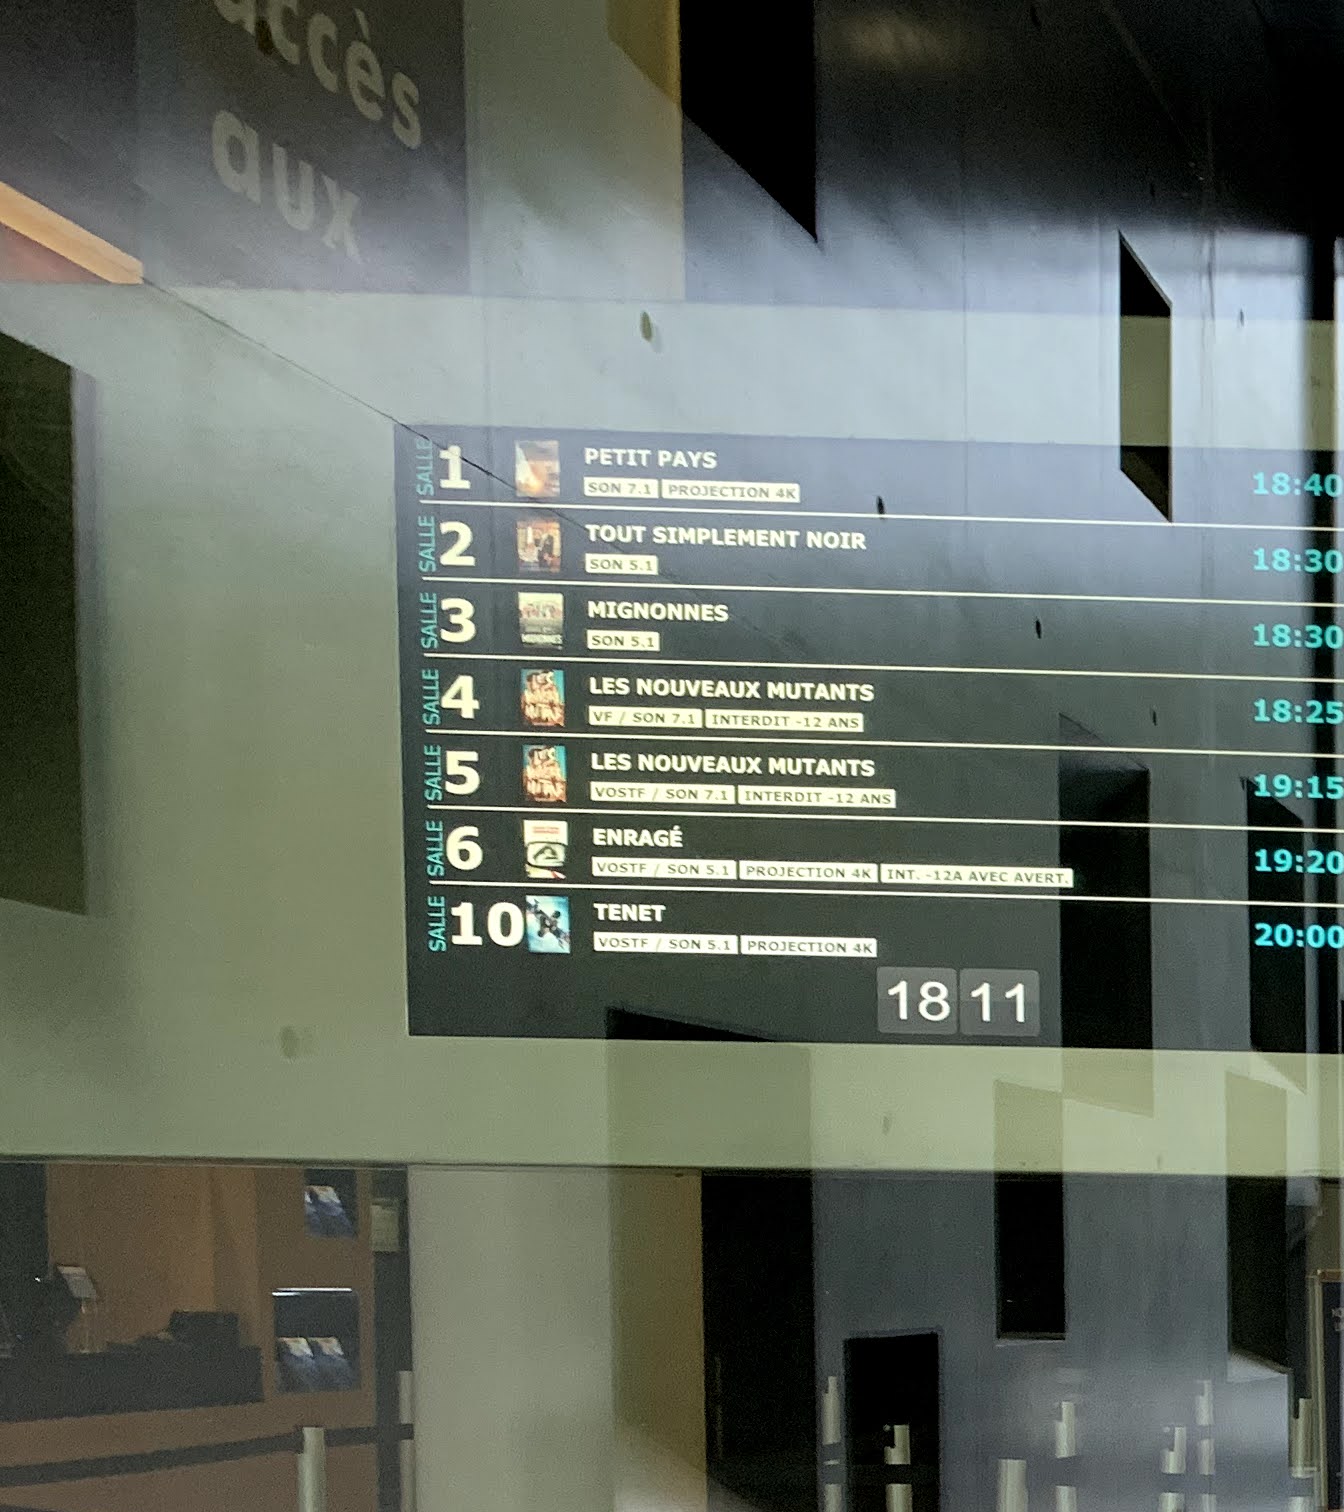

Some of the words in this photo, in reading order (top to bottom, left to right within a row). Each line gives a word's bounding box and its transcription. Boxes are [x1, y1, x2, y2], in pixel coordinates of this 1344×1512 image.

[211, 110, 362, 264] aux
[439, 445, 471, 489] 1
[585, 447, 650, 467] PETIT
[658, 450, 717, 469] PAYS
[587, 482, 622, 495] SON
[628, 483, 652, 495] 7.1
[668, 484, 769, 499] PROJECTION
[776, 487, 796, 499] 4K
[1252, 472, 1343, 498] 18:40
[440, 522, 475, 567] 2
[586, 524, 646, 544] TOUT
[652, 527, 799, 548] SIMPLEMENT
[807, 530, 866, 550] NOIR
[590, 558, 623, 572] SON
[628, 559, 652, 572] 5.1
[1252, 548, 1343, 573] 18:30
[440, 598, 475, 642] 3
[587, 601, 728, 622] MIGNONNES
[592, 634, 624, 648] SON
[630, 635, 655, 648] 5.1
[1252, 624, 1344, 649] 18:30
[423, 669, 439, 726] SALLE
[440, 675, 480, 718] 4
[590, 677, 630, 696] LES
[636, 678, 761, 699] NOUVEAUX
[768, 682, 874, 701] MUTANTS
[594, 712, 613, 724] VF
[632, 712, 665, 725] SON
[671, 712, 695, 725] 7.1
[712, 714, 790, 727] INTERDIT
[796, 716, 823, 728] -12
[829, 716, 860, 729] ANS
[1253, 700, 1344, 724] 18:25
[445, 750, 480, 795] 5
[591, 754, 631, 772] LES
[637, 754, 762, 775] NOUVEAUX
[768, 757, 875, 776] MUTANTS
[595, 786, 646, 799] VOSTF
[665, 788, 698, 800] SON
[705, 788, 728, 801] 7.1
[745, 789, 822, 803] INTERDIT
[828, 791, 854, 804] -12
[860, 791, 891, 804] ANS
[1254, 775, 1344, 799] 19:15
[446, 826, 483, 870] 6
[593, 825, 683, 849] ENRAGÉ
[597, 862, 647, 874] VOSTF
[667, 863, 699, 876] SON
[706, 864, 730, 877] 5.1
[746, 865, 846, 879] PROJECTION
[852, 868, 872, 879] 4K
[1255, 849, 1344, 875] 19:20
[886, 869, 921, 882] INT.
[926, 870, 965, 883] -12A
[969, 871, 1009, 884] AVEC
[1013, 872, 1070, 885] AVERT.
[429, 896, 446, 952] SALLE
[450, 901, 524, 947] 10
[594, 903, 665, 922] TENET
[599, 937, 649, 950] VOSTF
[669, 938, 701, 951] SON
[707, 940, 731, 951] 5.1
[747, 940, 847, 954] PROJECTION
[853, 942, 874, 954] 4K
[886, 980, 951, 1021] 18
[969, 983, 1026, 1022] 11
